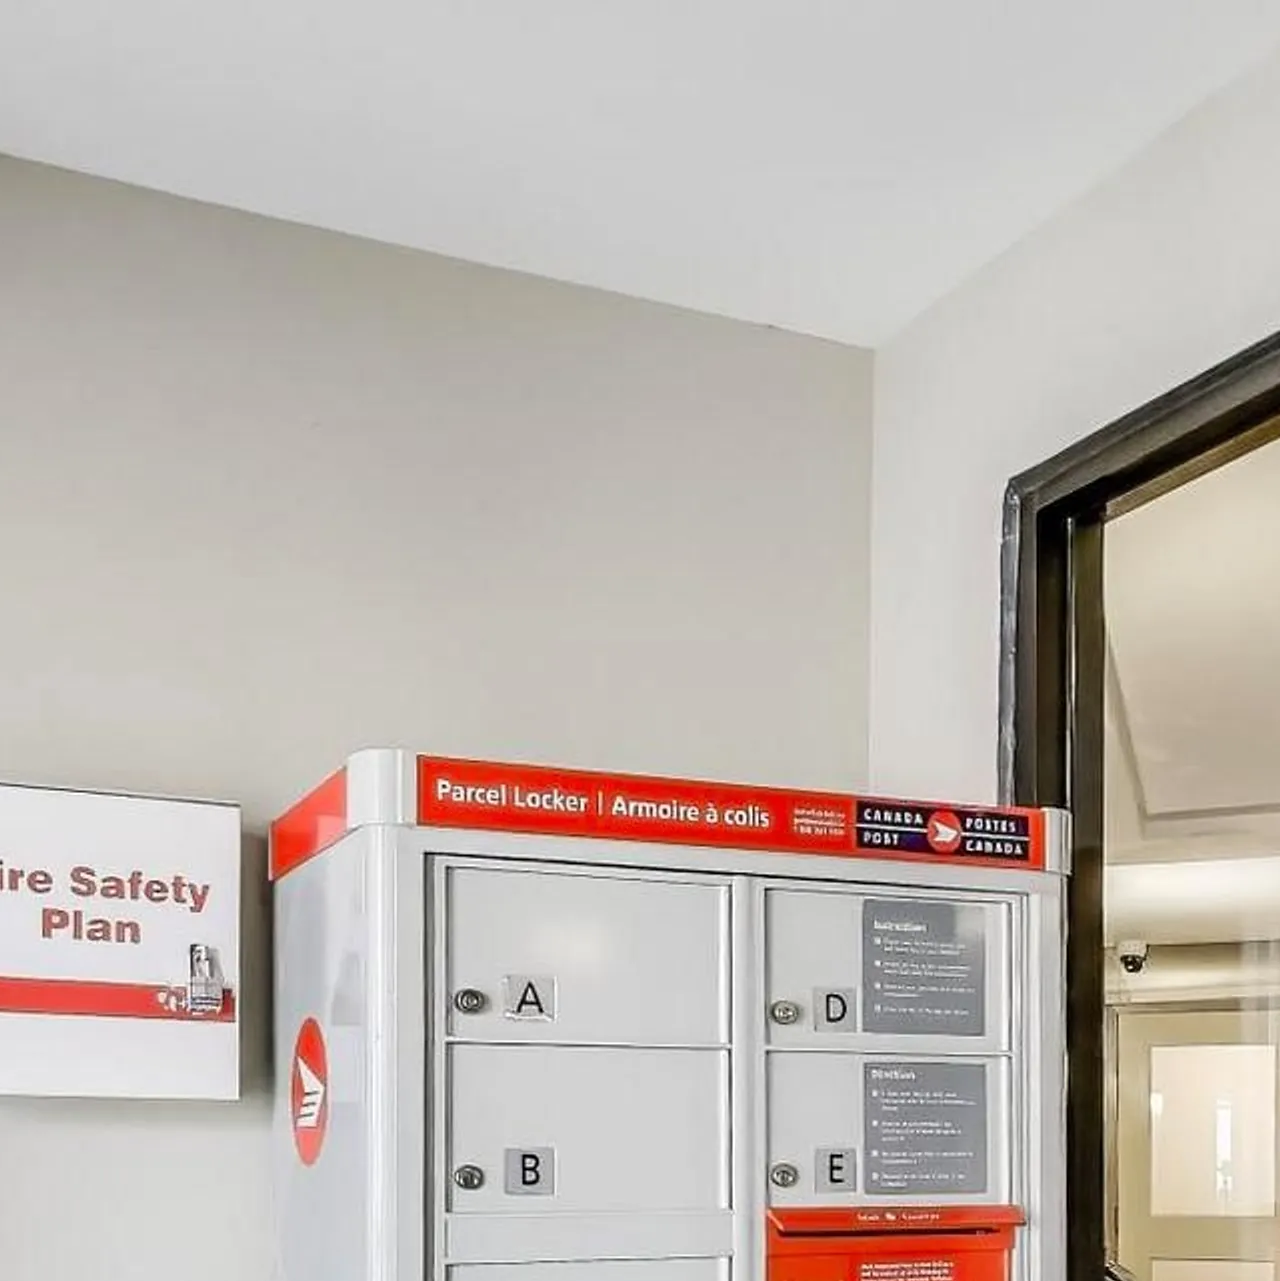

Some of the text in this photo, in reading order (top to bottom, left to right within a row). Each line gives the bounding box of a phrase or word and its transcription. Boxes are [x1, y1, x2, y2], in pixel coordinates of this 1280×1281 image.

[436, 778, 589, 813] Parcel Locker
[611, 795, 700, 823] Armoire
[706, 803, 718, 824] à
[723, 806, 771, 829] colis
[863, 808, 923, 824] CANADA
[965, 817, 1017, 834] POSTES
[863, 831, 900, 846] POST
[965, 839, 1024, 856] CANADA
[69, 865, 211, 914] Safety
[41, 907, 142, 945] Plan
[516, 980, 545, 1014] A
[826, 993, 847, 1023] D
[521, 1153, 541, 1186] B
[829, 1153, 845, 1184] E
